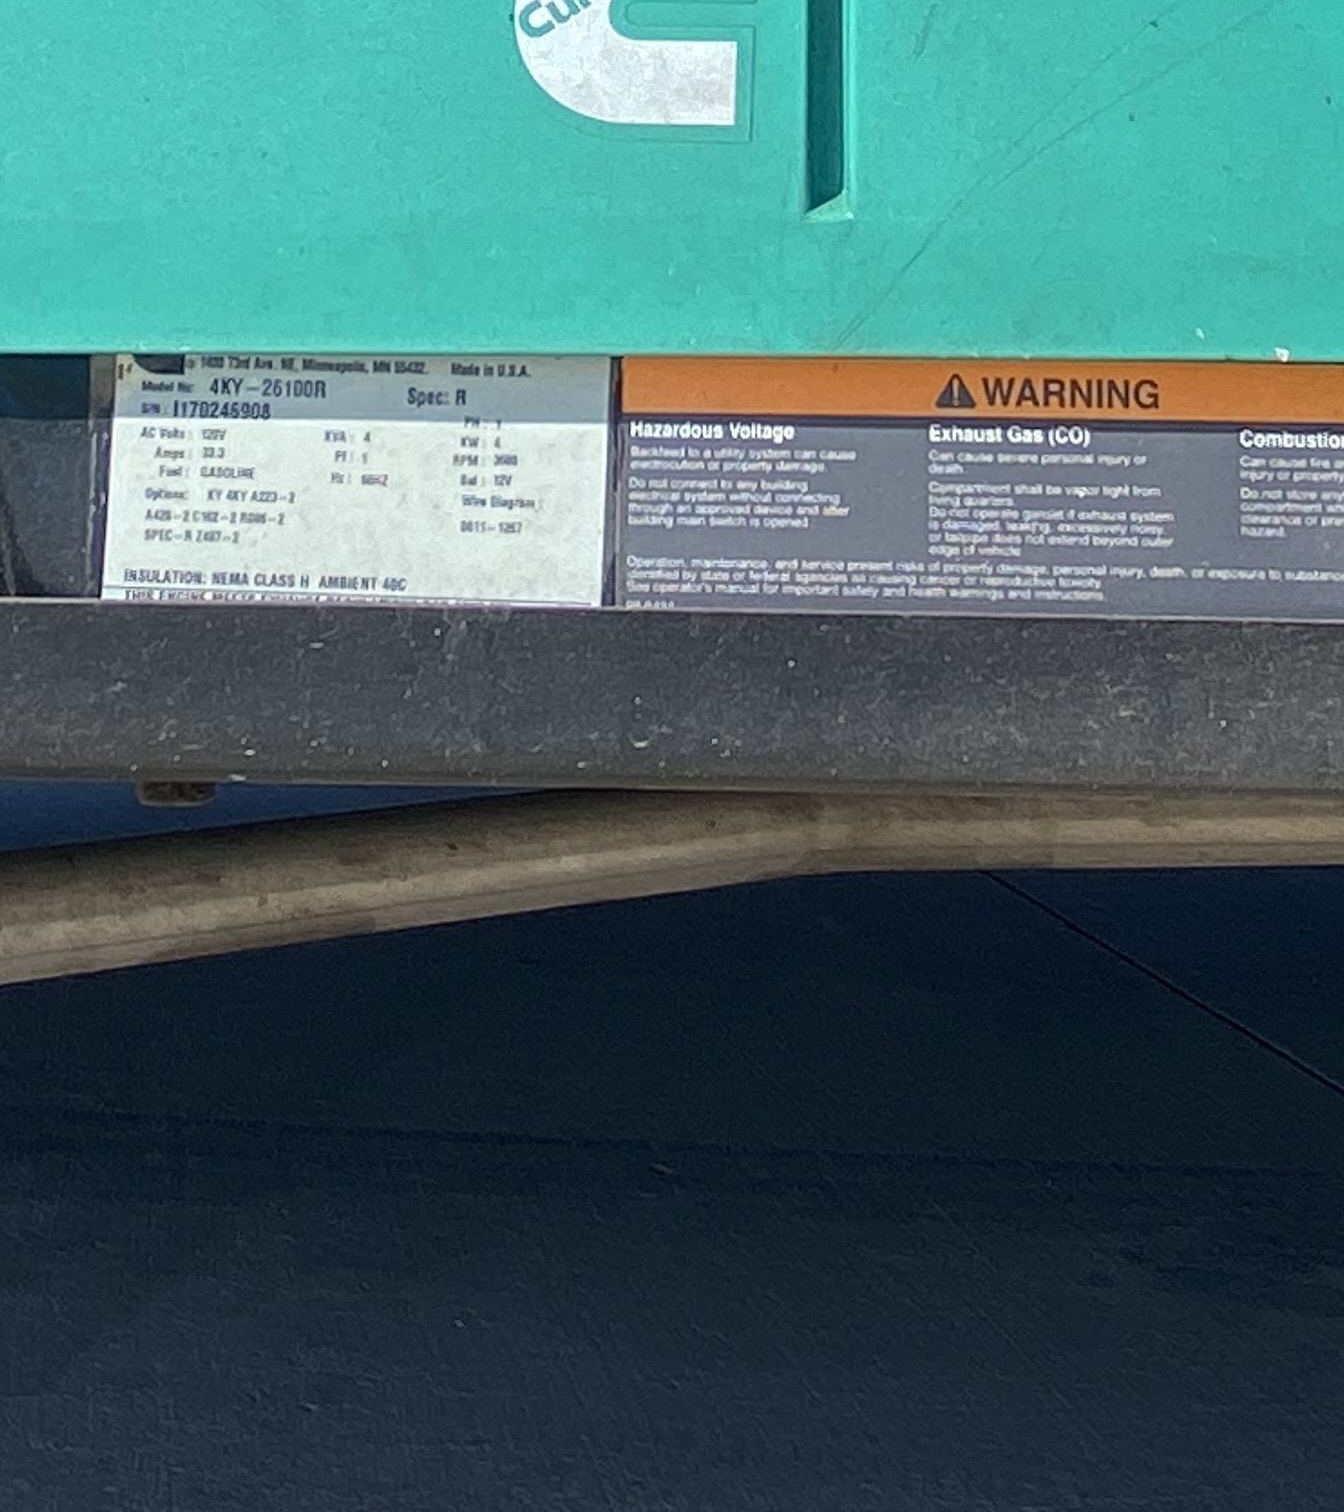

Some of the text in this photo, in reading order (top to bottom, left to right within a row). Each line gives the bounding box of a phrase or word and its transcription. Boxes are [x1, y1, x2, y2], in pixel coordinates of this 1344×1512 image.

[406, 387, 466, 407] Spec: R
[982, 377, 1159, 409] WARNING
[630, 421, 795, 444] Hazardous Voltage
[928, 424, 1091, 448] Exhaust Gas (CO)
[123, 568, 206, 585] INSULATION:
[211, 571, 249, 586] NEMA
[255, 573, 295, 588] CLASS
[318, 576, 376, 590] AMBIENT
